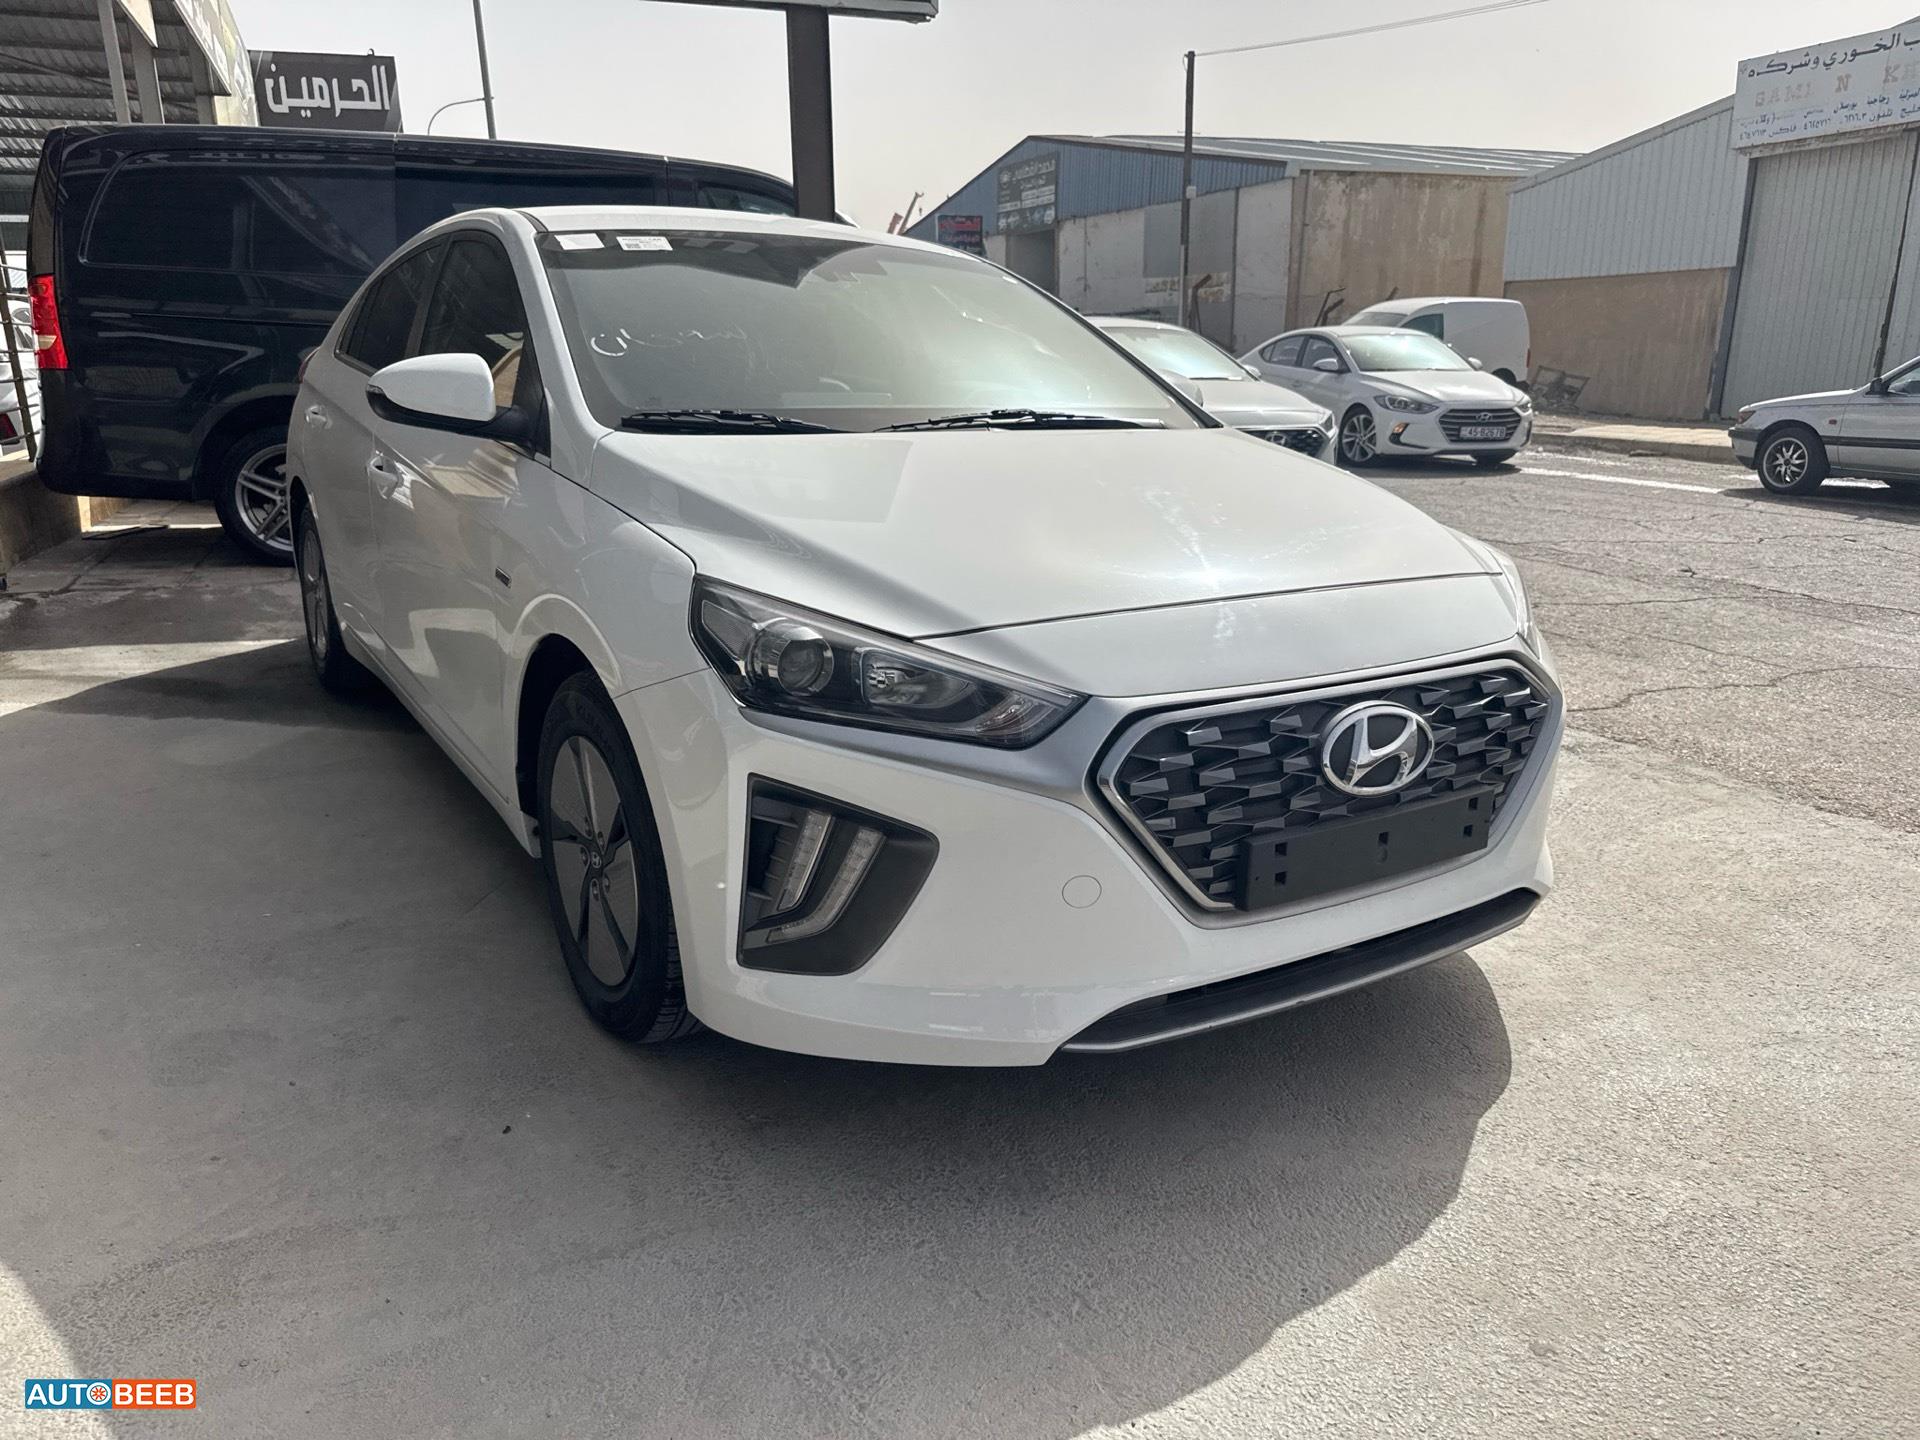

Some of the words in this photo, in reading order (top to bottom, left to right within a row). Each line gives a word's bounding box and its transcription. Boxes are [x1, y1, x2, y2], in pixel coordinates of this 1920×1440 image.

[1823, 32, 1901, 71] الخوري
[264, 63, 391, 118] الحرمين
[1834, 73, 1853, 94] N
